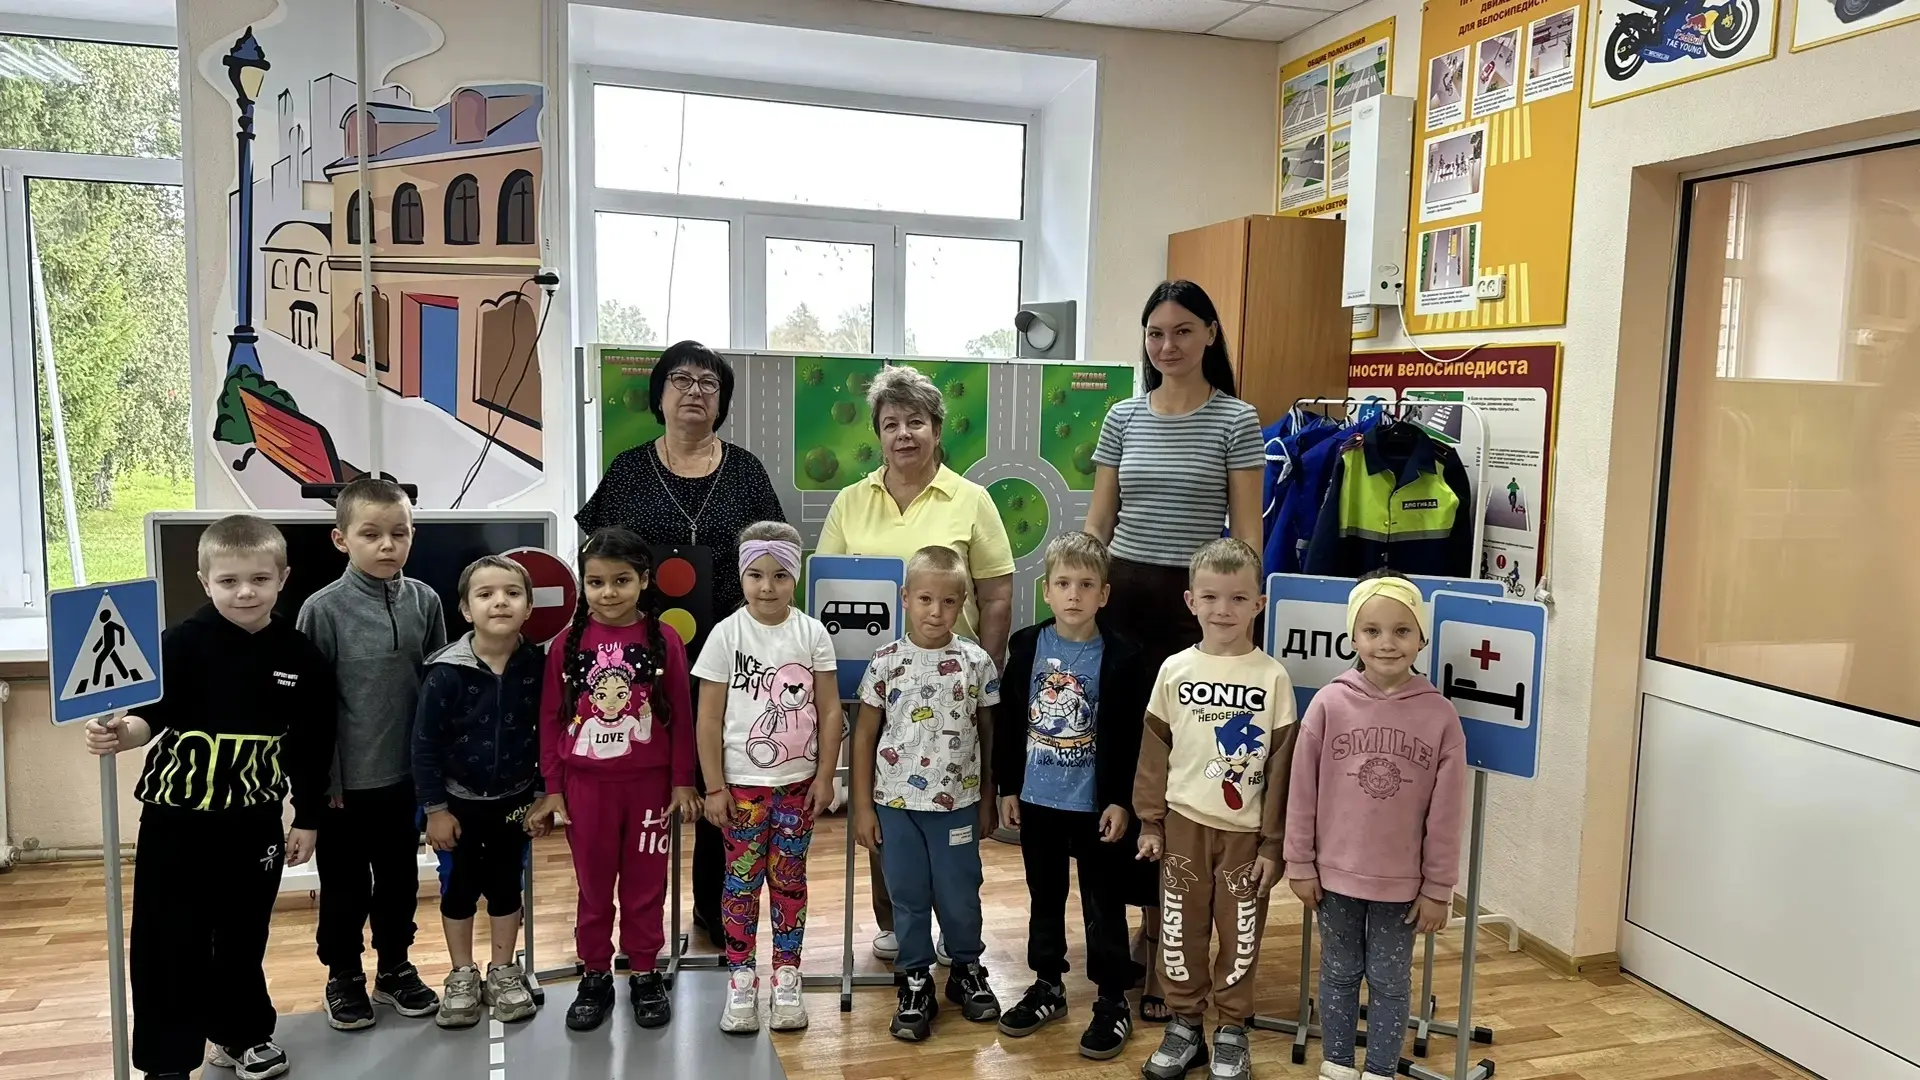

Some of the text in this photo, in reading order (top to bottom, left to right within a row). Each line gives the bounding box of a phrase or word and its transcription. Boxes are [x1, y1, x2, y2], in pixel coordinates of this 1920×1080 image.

[1458, 21, 1475, 36] ДЛЯ
[1307, 36, 1366, 68] ОБЩИЕ ПОЛОЖЕНИЯ
[1665, 37, 1702, 55] TAE YOUNG
[1299, 204, 1325, 217] СИГНАЛЫ
[1397, 359, 1528, 378] велосипедиста
[597, 642, 622, 652] FUN
[735, 650, 764, 675] NICE
[1179, 682, 1267, 711] SONIC
[1192, 708, 1205, 716] THE
[595, 732, 625, 744] LOVE
[1331, 727, 1433, 770] SMILE
[1162, 889, 1190, 982] GO FAST!
